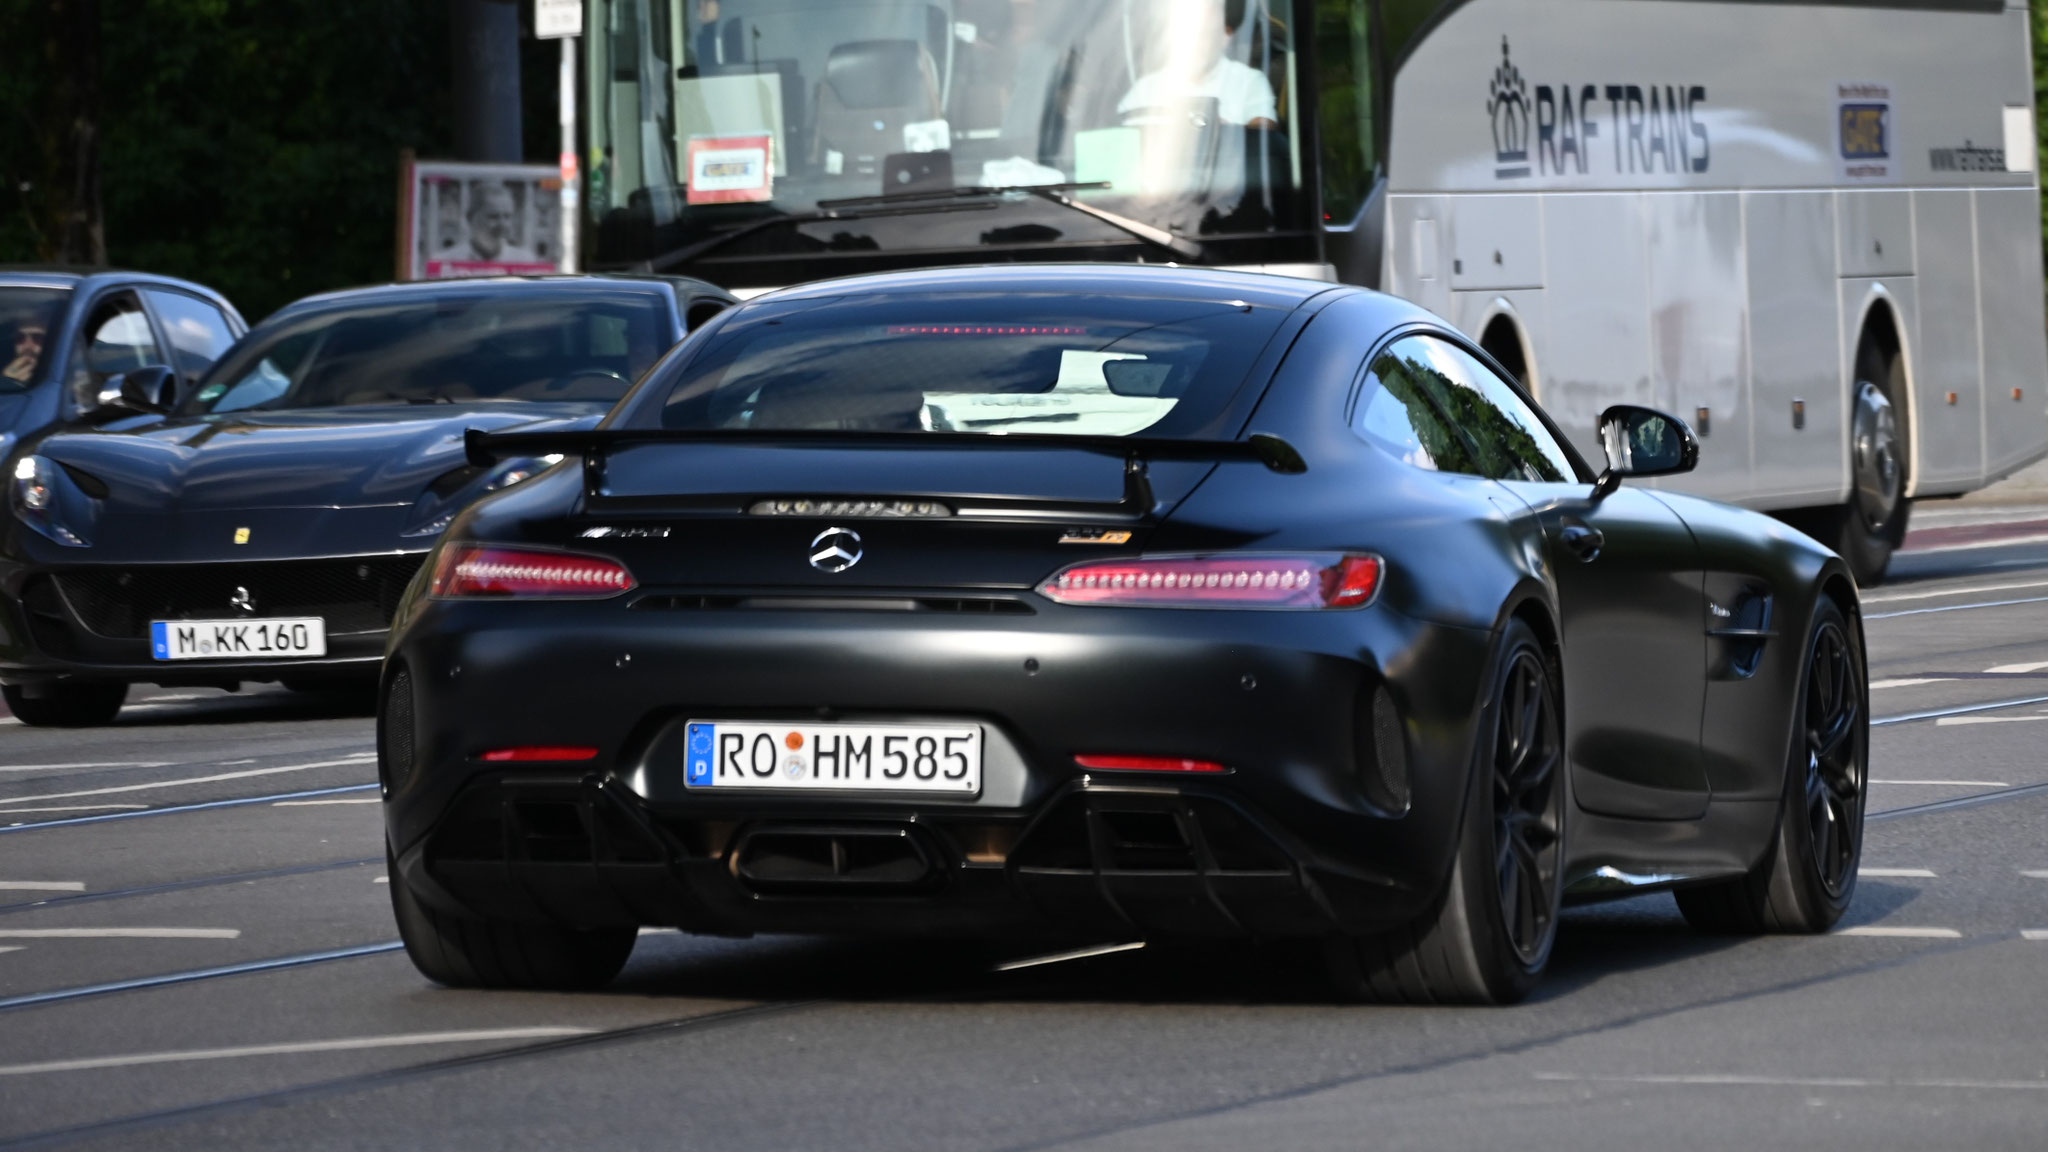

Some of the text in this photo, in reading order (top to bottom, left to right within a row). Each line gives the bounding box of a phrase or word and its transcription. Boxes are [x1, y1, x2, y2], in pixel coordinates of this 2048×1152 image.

[1536, 84, 1710, 175] RAF TRANS
[177, 624, 309, 653] M KK 160
[719, 733, 970, 781] RO HM 585
